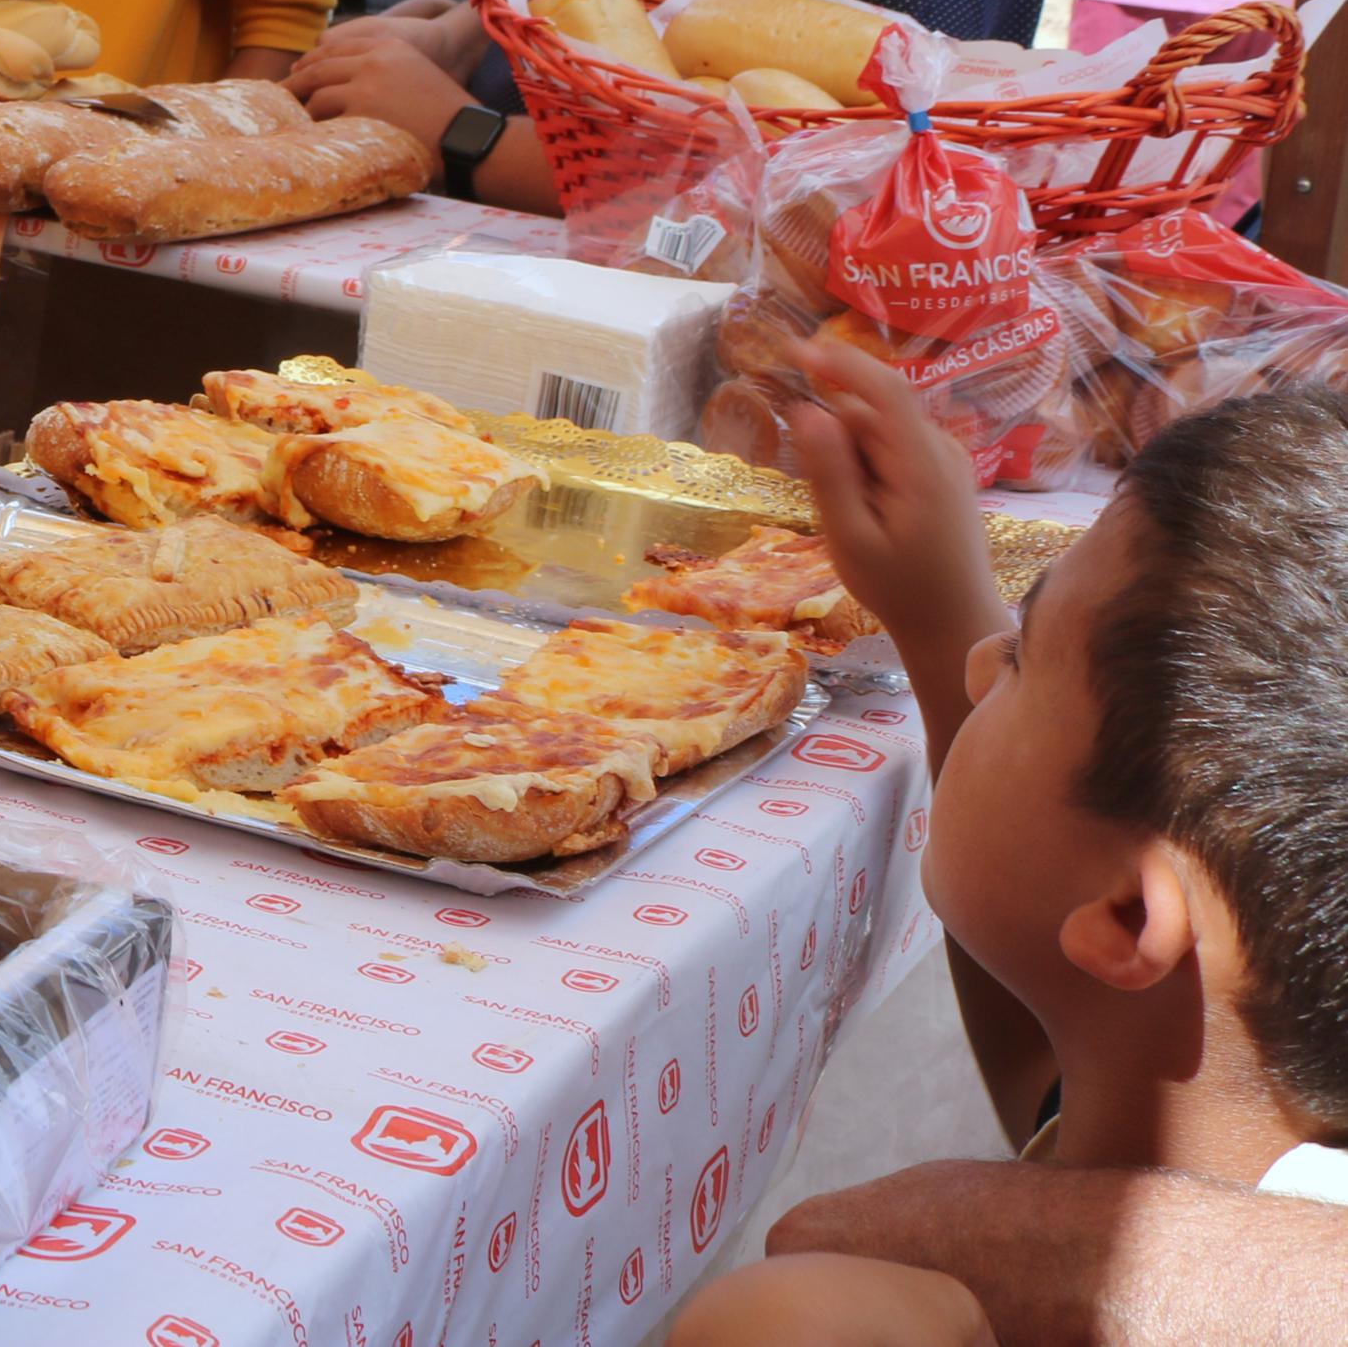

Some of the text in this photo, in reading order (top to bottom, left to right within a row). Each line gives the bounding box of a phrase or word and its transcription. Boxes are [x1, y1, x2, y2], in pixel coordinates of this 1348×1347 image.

[843, 247, 1032, 291] SAN FRANCIS
[910, 297, 972, 310] DESDE
[898, 311, 1055, 387] ALENAS CASERAS
[774, 777, 866, 823] FRANCISCO
[692, 812, 812, 875] AN FRANCISCO
[230, 860, 386, 900] SAN FRANCISCO
[616, 868, 750, 935] SAN FRANCISCO
[186, 912, 308, 950] FRANCISCO
[346, 922, 389, 938] SAN
[537, 935, 672, 1007] SAN FRANCISCO
[249, 988, 421, 1037] SAN FRANCISCO
[460, 995, 600, 1076] SAN FRANCISCO
[166, 1066, 334, 1122] AN FRANCISCO
[708, 1012, 718, 1127] FRANCISCO
[376, 1066, 519, 1158] SAN FRANCISCO
[627, 1035, 641, 1202] SAN FRANCISCO
[102, 1173, 223, 1197] RANCISCO
[664, 1163, 674, 1204] SAN
[262, 1159, 312, 1174] SAN
[313, 1170, 410, 1265] FRANCISCO
[151, 1239, 206, 1260] SAN
[585, 1236, 596, 1276] SAN
